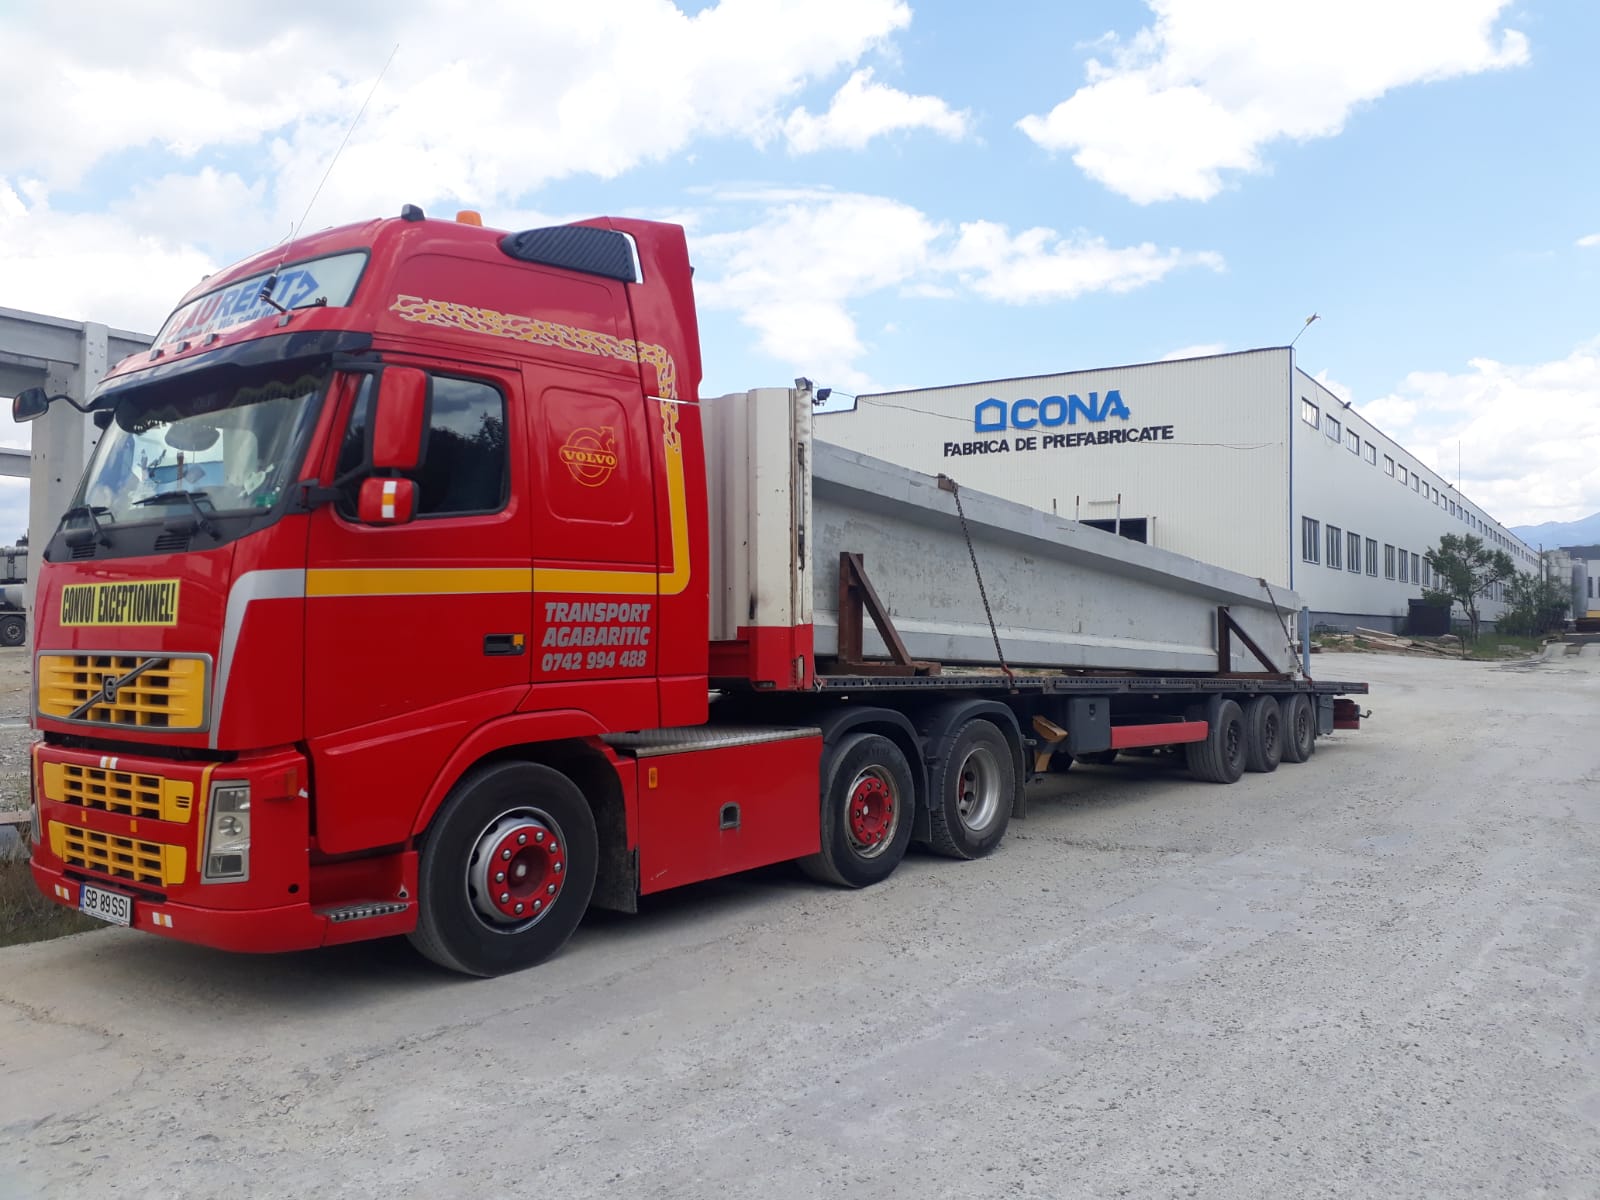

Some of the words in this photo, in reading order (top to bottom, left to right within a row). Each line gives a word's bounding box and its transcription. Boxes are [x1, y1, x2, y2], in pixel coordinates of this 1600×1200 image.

[1010, 390, 1131, 430] CONA
[944, 438, 1010, 457] FABRICA
[1015, 436, 1037, 451] DE
[1043, 425, 1174, 449] PREFABRICATE
[563, 450, 616, 466] VOLVO
[62, 585, 96, 625] CONVOI
[98, 581, 176, 624] EXCEPTIONNEL!
[545, 602, 651, 623] TRANSPORT
[542, 626, 651, 648] AGABARITIC
[542, 652, 582, 672] 0742
[587, 651, 615, 670] 994
[619, 650, 647, 668] 488
[85, 888, 98, 909] SB
